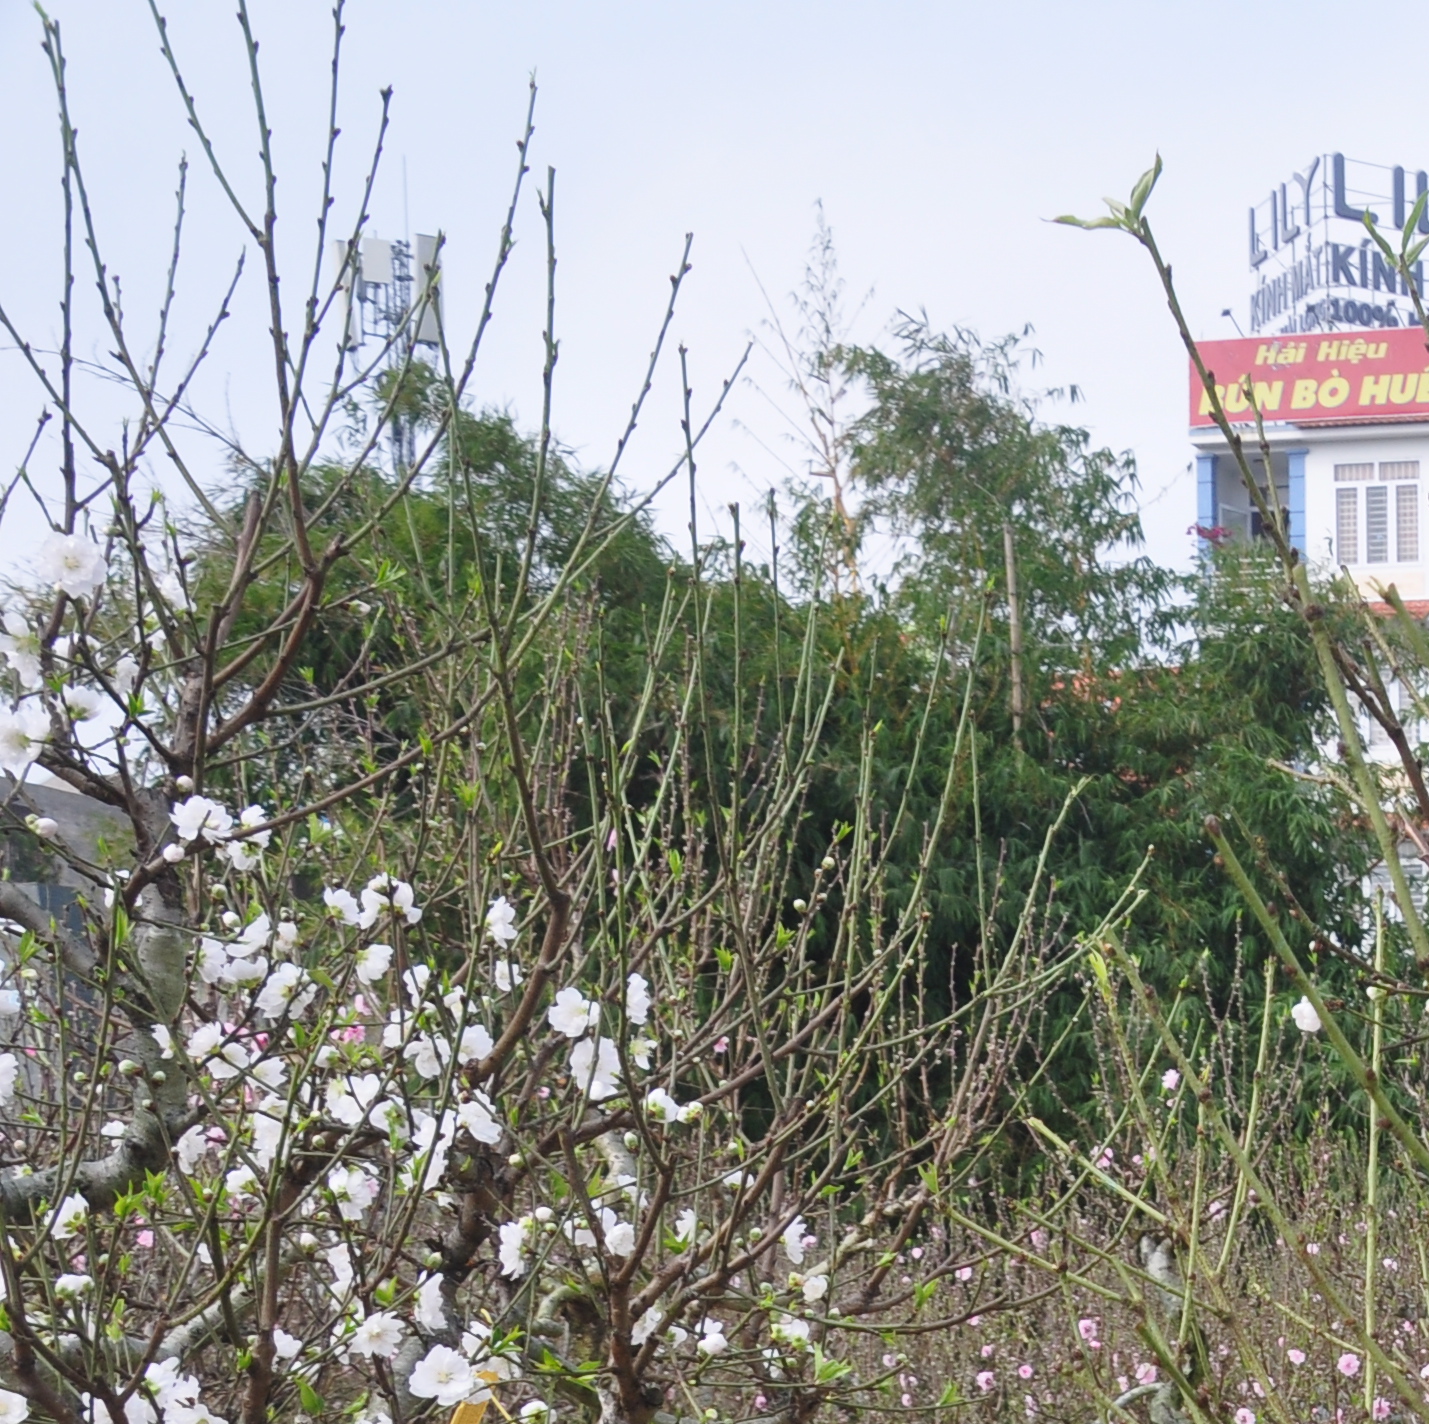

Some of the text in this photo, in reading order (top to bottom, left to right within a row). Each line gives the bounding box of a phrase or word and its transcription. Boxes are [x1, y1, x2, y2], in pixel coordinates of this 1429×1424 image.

[1332, 238, 1424, 301] KÍNH
[1330, 298, 1400, 328] 100%
[1254, 338, 1389, 366] Hải Hiệu
[1198, 374, 1284, 416] BÚN
[1290, 369, 1351, 410] BÒ
